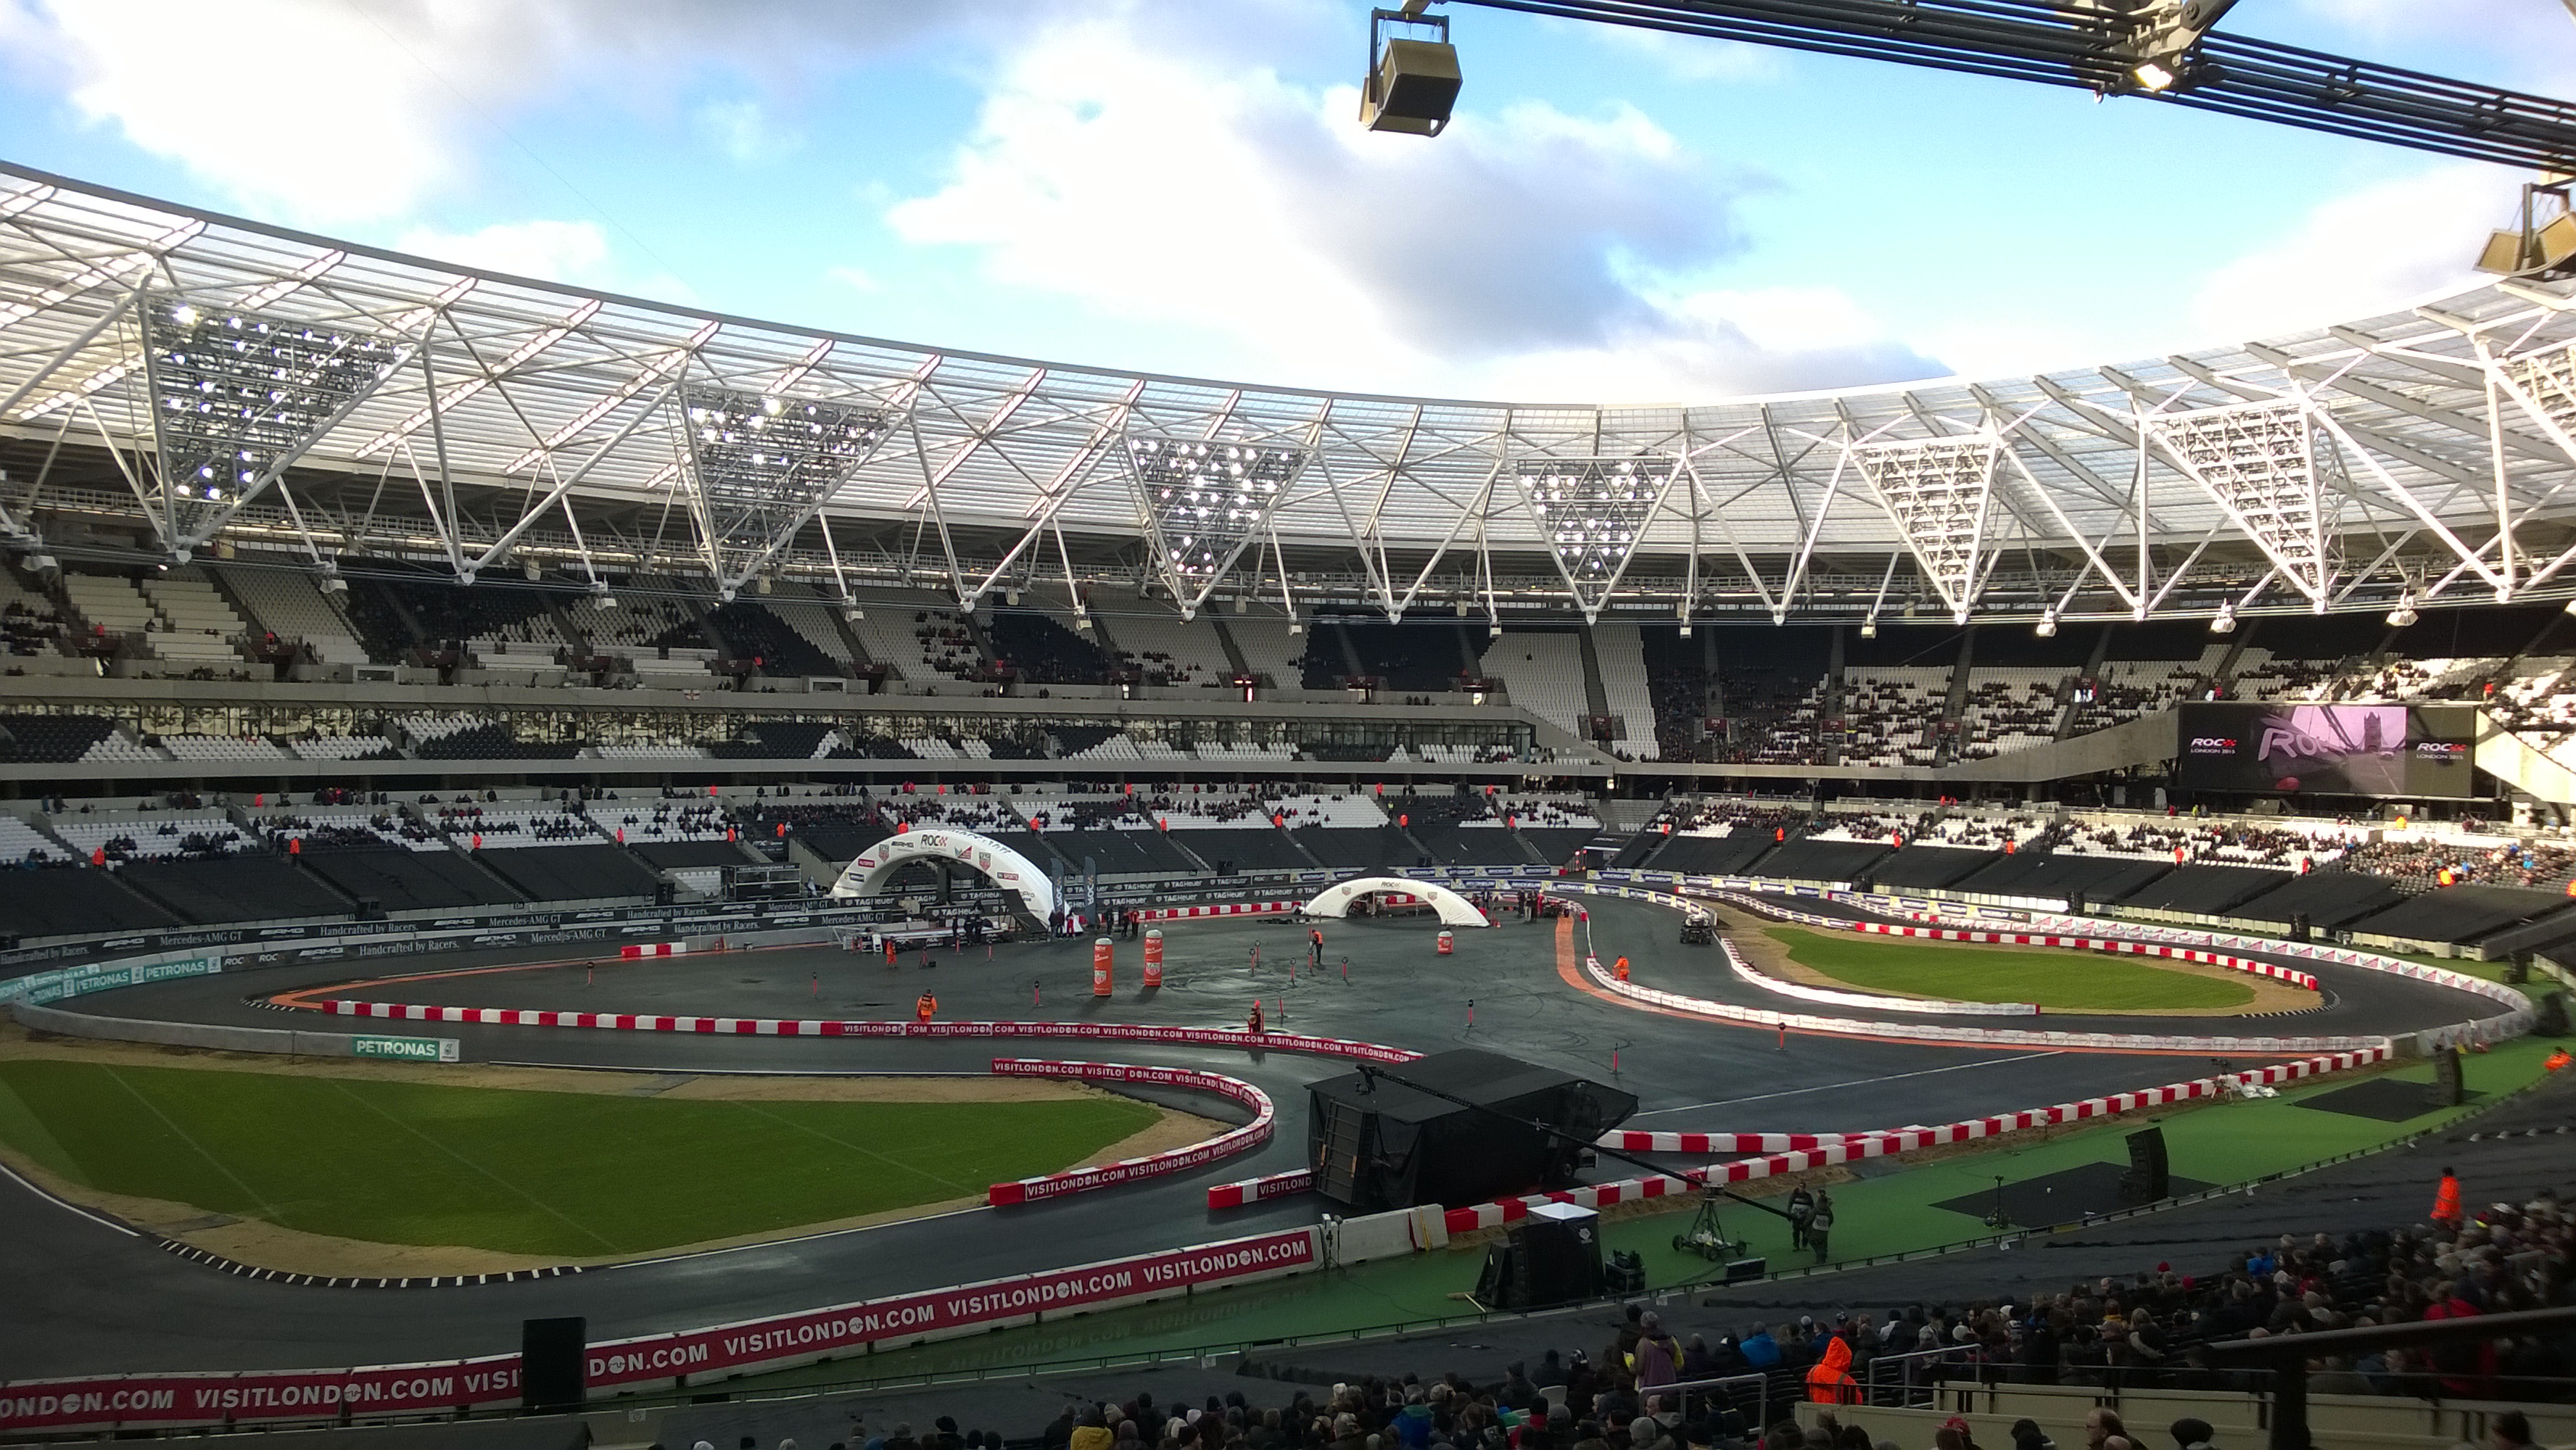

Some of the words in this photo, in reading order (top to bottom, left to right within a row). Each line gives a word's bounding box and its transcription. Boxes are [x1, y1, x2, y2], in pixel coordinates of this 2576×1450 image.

[2190, 738, 2226, 747] ROC
[2416, 743, 2453, 752] ROC
[921, 834, 939, 846] ROC
[1124, 882, 1157, 891] TAGHeuer
[1171, 879, 1203, 888] TAGHeuer
[1217, 877, 1248, 886] TAGHeuer
[1213, 891, 1247, 900] TAGHeuer
[1261, 888, 1294, 897] TAGHeuer
[819, 900, 829, 908] GT
[855, 898, 895, 906] TAGHeuer
[1112, 897, 1147, 906] TAGHeuer
[1163, 894, 1198, 903] TAGHeuer
[627, 908, 672, 919] Handcrafted
[673, 908, 683, 916] by
[684, 906, 709, 916] Racers.
[489, 914, 549, 927] Mercedes-AMG
[550, 914, 562, 924] GT
[821, 913, 875, 925] Mercedes-AMG
[875, 912, 886, 921] GT
[321, 924, 374, 937] Handcrafted
[375, 923, 387, 935] by
[388, 921, 419, 932] Racers.
[674, 921, 721, 933] Handcrafted
[160, 932, 228, 947] Mercedes-AMG
[229, 931, 243, 942] GT
[595, 928, 608, 939] GT
[359, 943, 413, 956] Handcrafted
[415, 942, 426, 954] by
[428, 940, 460, 951] Racers.
[224, 957, 244, 966] ROC
[259, 953, 279, 963] ROC
[146, 962, 205, 979] PETRONAS
[77, 972, 129, 990] PETRONAS
[356, 1040, 437, 1057] PETRONAS
[1018, 1025, 1100, 1035] VISITLONDON.COM
[1103, 1027, 1183, 1038] VISITLONDON.COM
[1186, 1031, 1264, 1044] VISITLONDON.COM
[1268, 1037, 1342, 1052] VISITLONDON.COM
[1345, 1045, 1410, 1063] VISITLONDON.COM
[994, 1063, 1083, 1074] VISITLONDON.COM
[1027, 1169, 1126, 1197] VISITLONDON.COM
[1128, 1149, 1210, 1177] VISITLONDON.COM
[195, 1377, 454, 1409] VISITLONDON.COM
[724, 1304, 935, 1356] VISITLONDON.COM
[948, 1270, 1133, 1317] VISITLONDON.COM
[1143, 1240, 1308, 1283] VISITLONDON.COM
